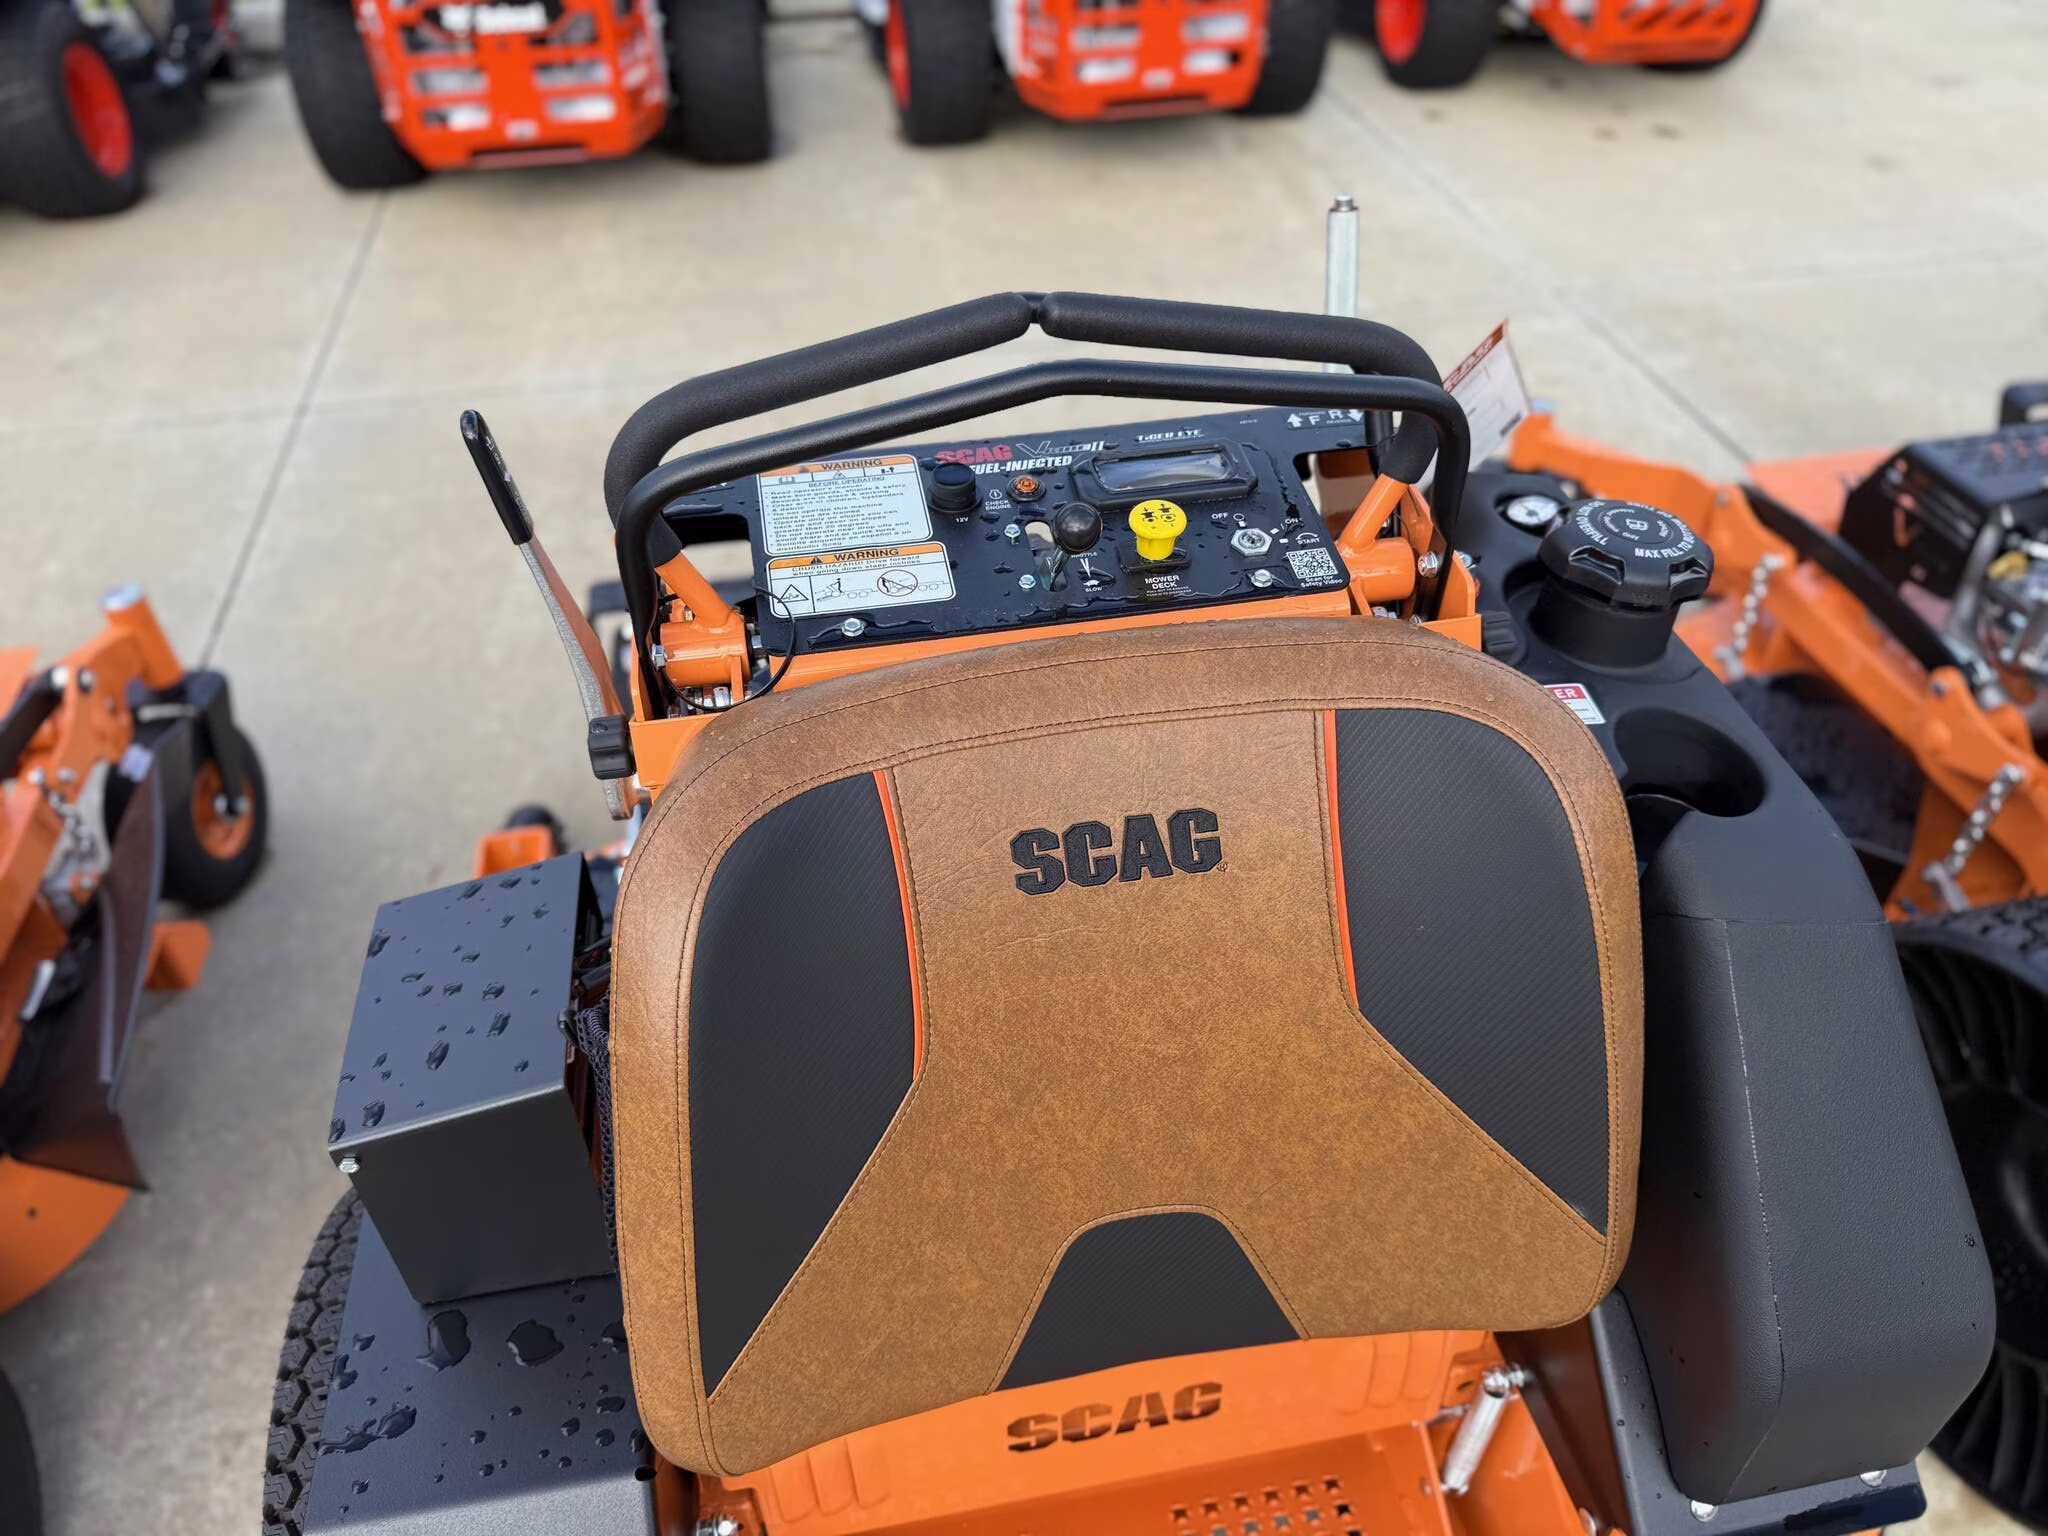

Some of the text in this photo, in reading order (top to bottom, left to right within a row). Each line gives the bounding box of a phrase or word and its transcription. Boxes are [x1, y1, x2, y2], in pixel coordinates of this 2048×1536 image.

[1308, 410, 1343, 425] F R
[1177, 429, 1200, 438] EYE
[936, 444, 1012, 464] SCAG
[821, 459, 882, 470] WARNING
[1576, 516, 1608, 546] OVERFILL
[834, 548, 899, 561] WARNING
[1634, 548, 1661, 558] MAX
[1660, 547, 1684, 558] FILL
[1677, 541, 1693, 552] TO
[1145, 575, 1179, 584] MOWER
[1010, 808, 1222, 896] SCAG
[1007, 1382, 1222, 1452] SCAG
